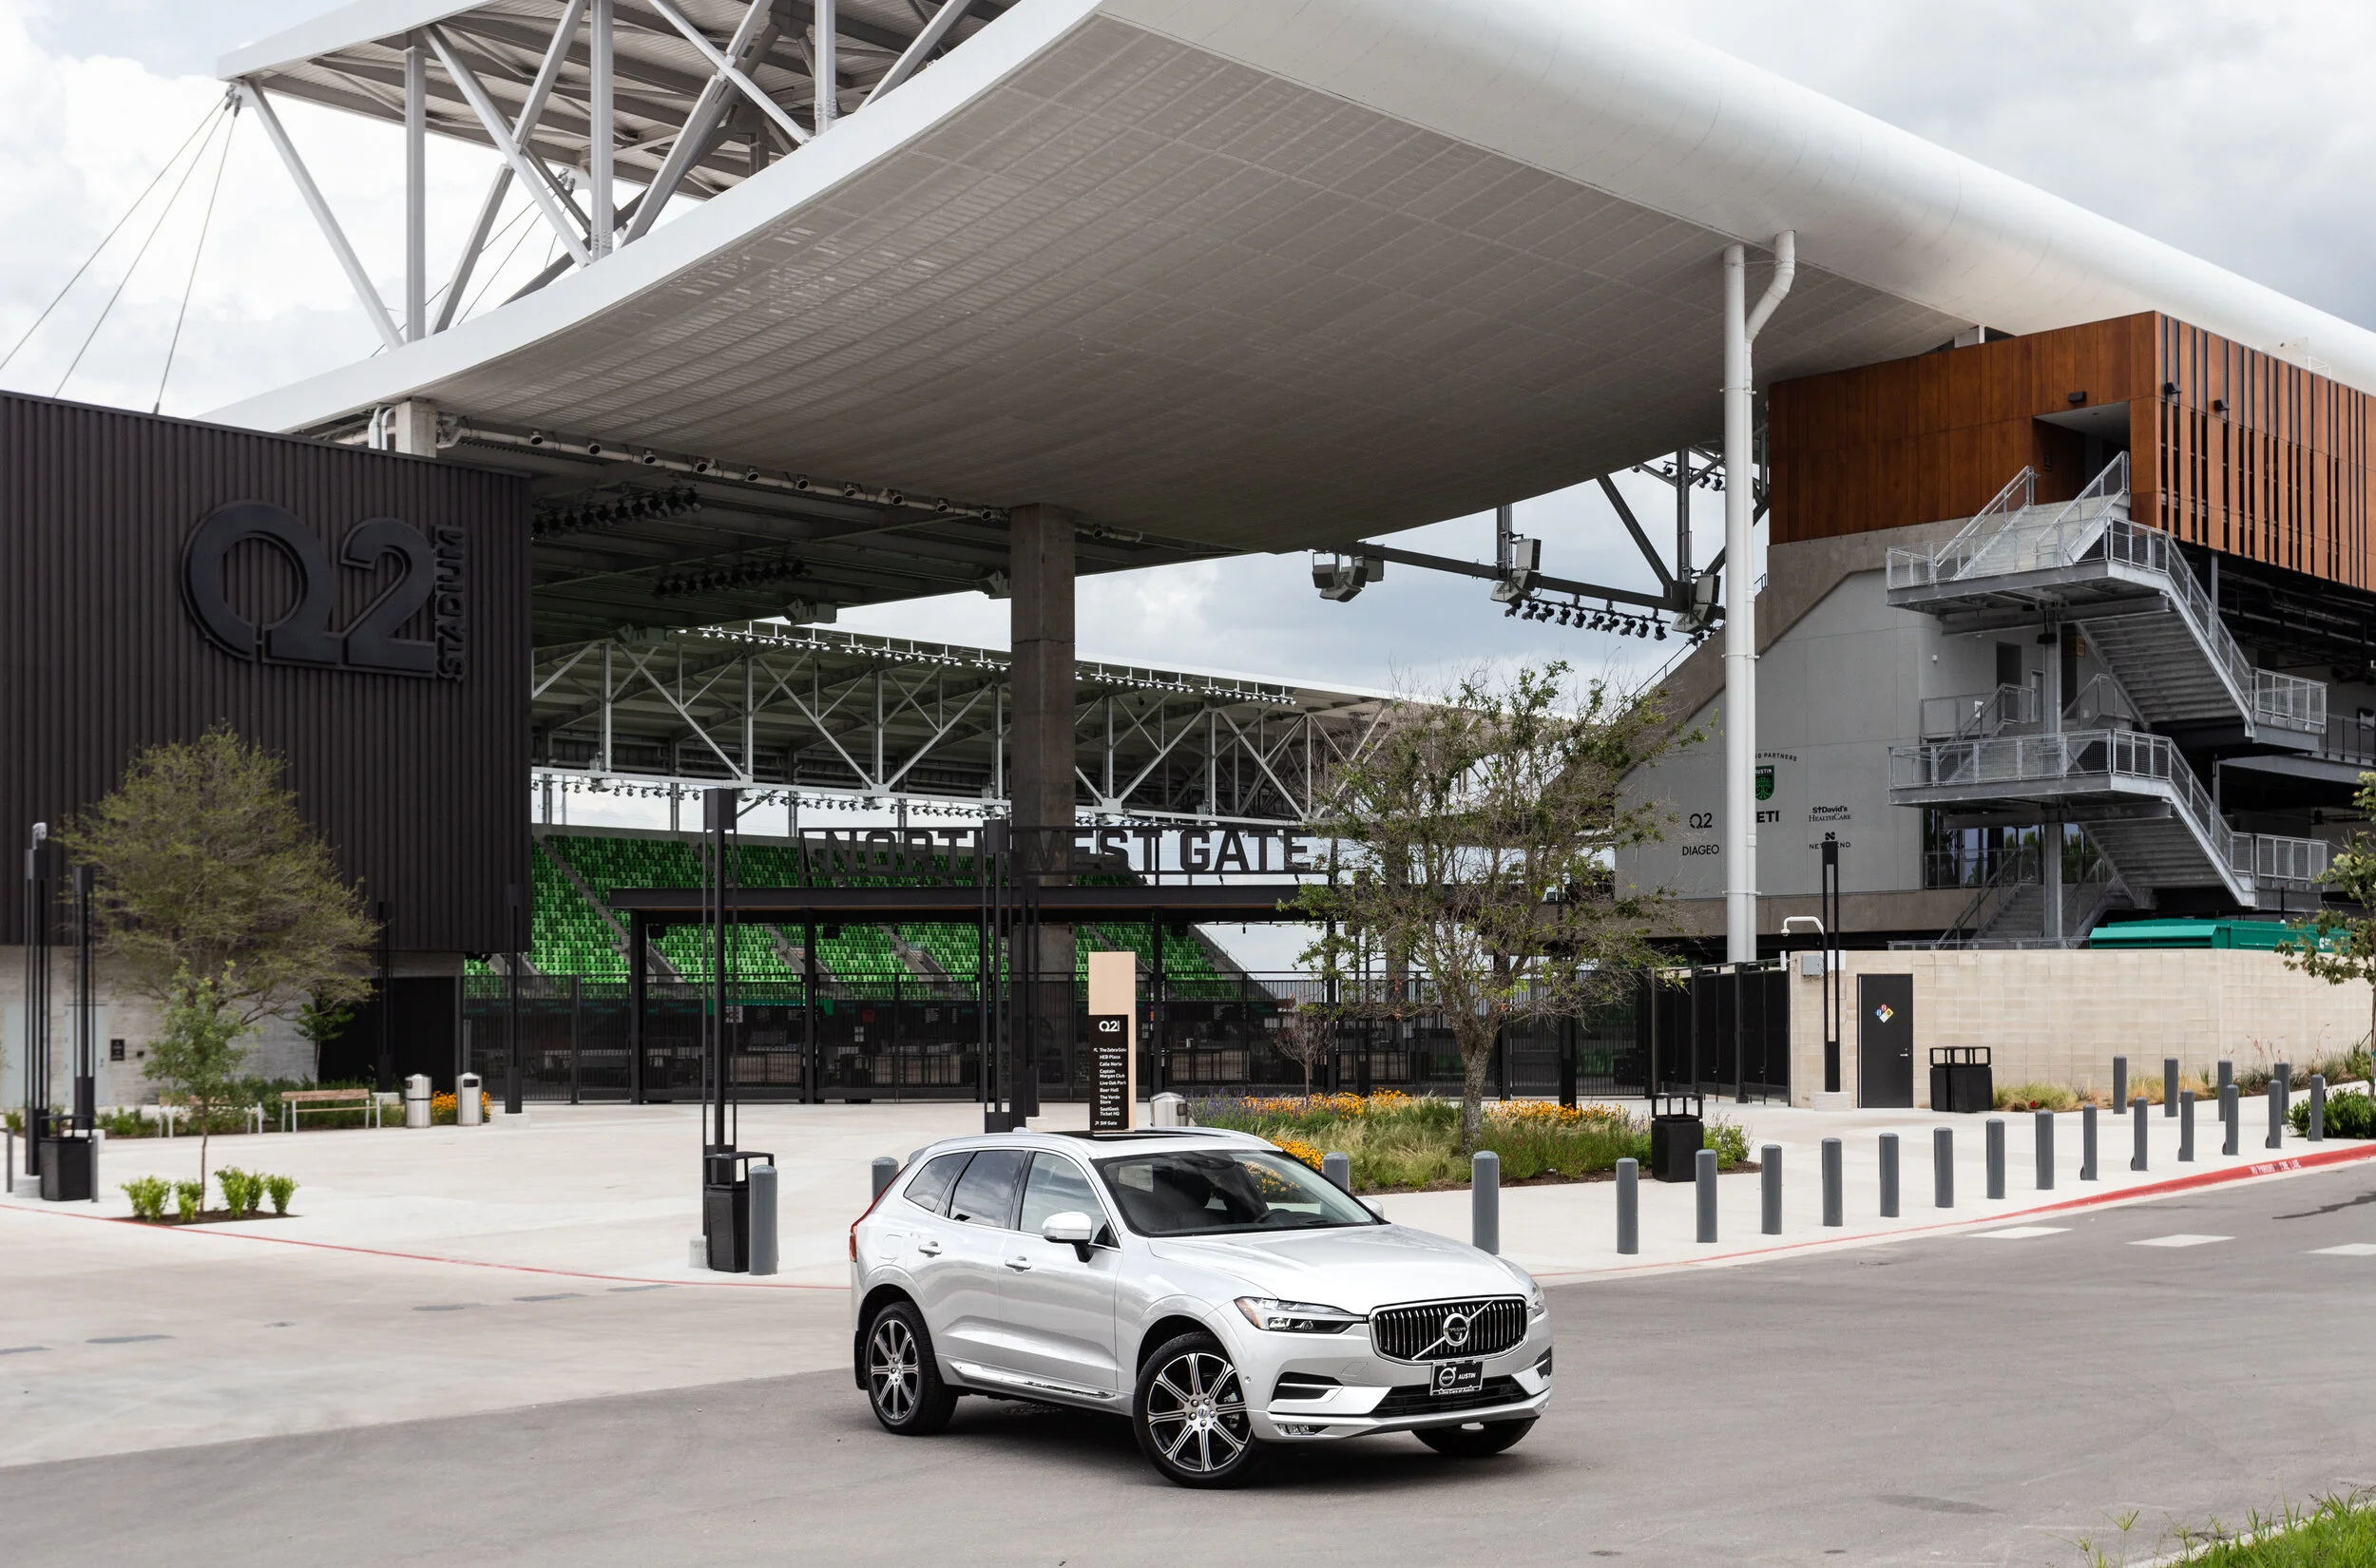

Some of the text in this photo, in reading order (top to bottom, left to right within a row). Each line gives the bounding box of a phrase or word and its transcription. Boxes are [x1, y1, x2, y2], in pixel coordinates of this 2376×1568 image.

[181, 499, 436, 679] Q2
[435, 524, 467, 681] STADIUM
[1763, 753, 1797, 761] PARTNERS
[1689, 813, 1712, 830] Q2
[1756, 811, 1780, 823] ETI
[826, 830, 1311, 871] NORTWEST GATE
[1681, 844, 1720, 856] DIAGEO
[1099, 1021, 1118, 1032] Q2
